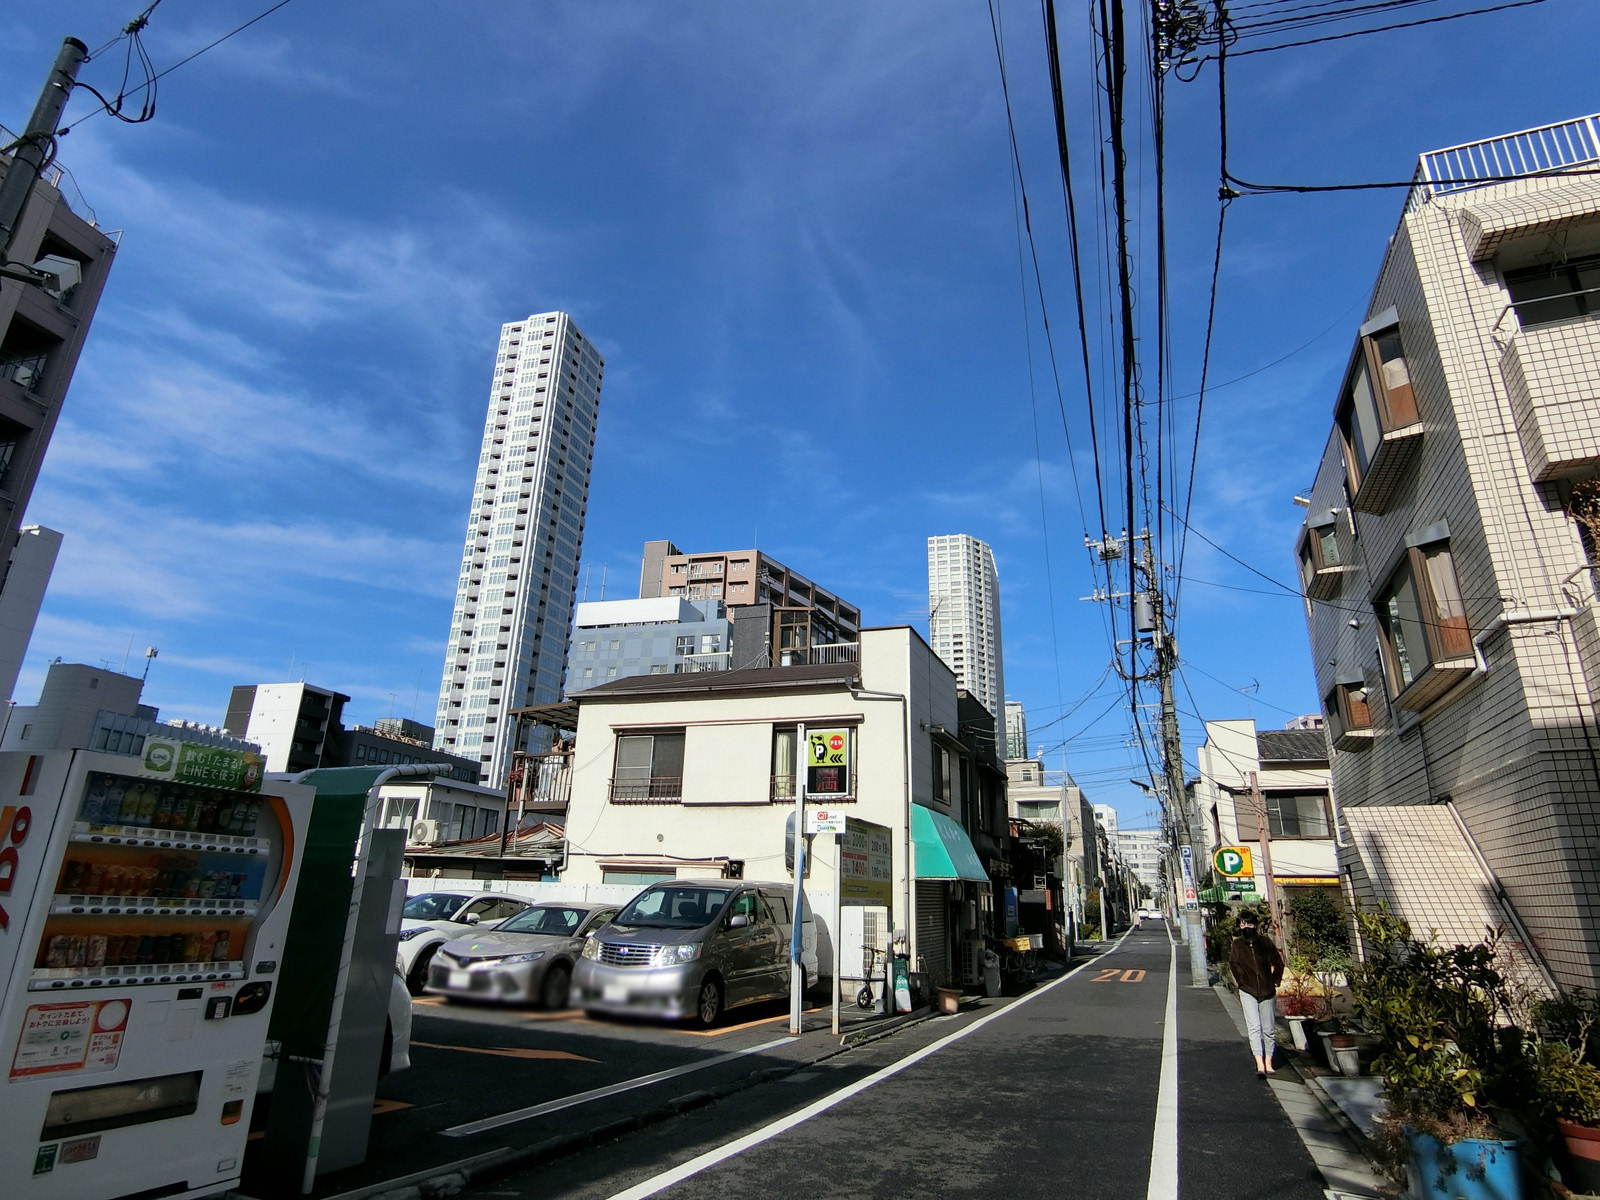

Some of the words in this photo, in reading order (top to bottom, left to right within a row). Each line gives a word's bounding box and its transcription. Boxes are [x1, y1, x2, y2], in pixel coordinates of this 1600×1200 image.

[153, 753, 168, 761] LINE
[816, 745, 824, 758] P
[1182, 848, 1190, 858] P
[1223, 852, 1240, 872] P
[1090, 969, 1147, 982] 20
